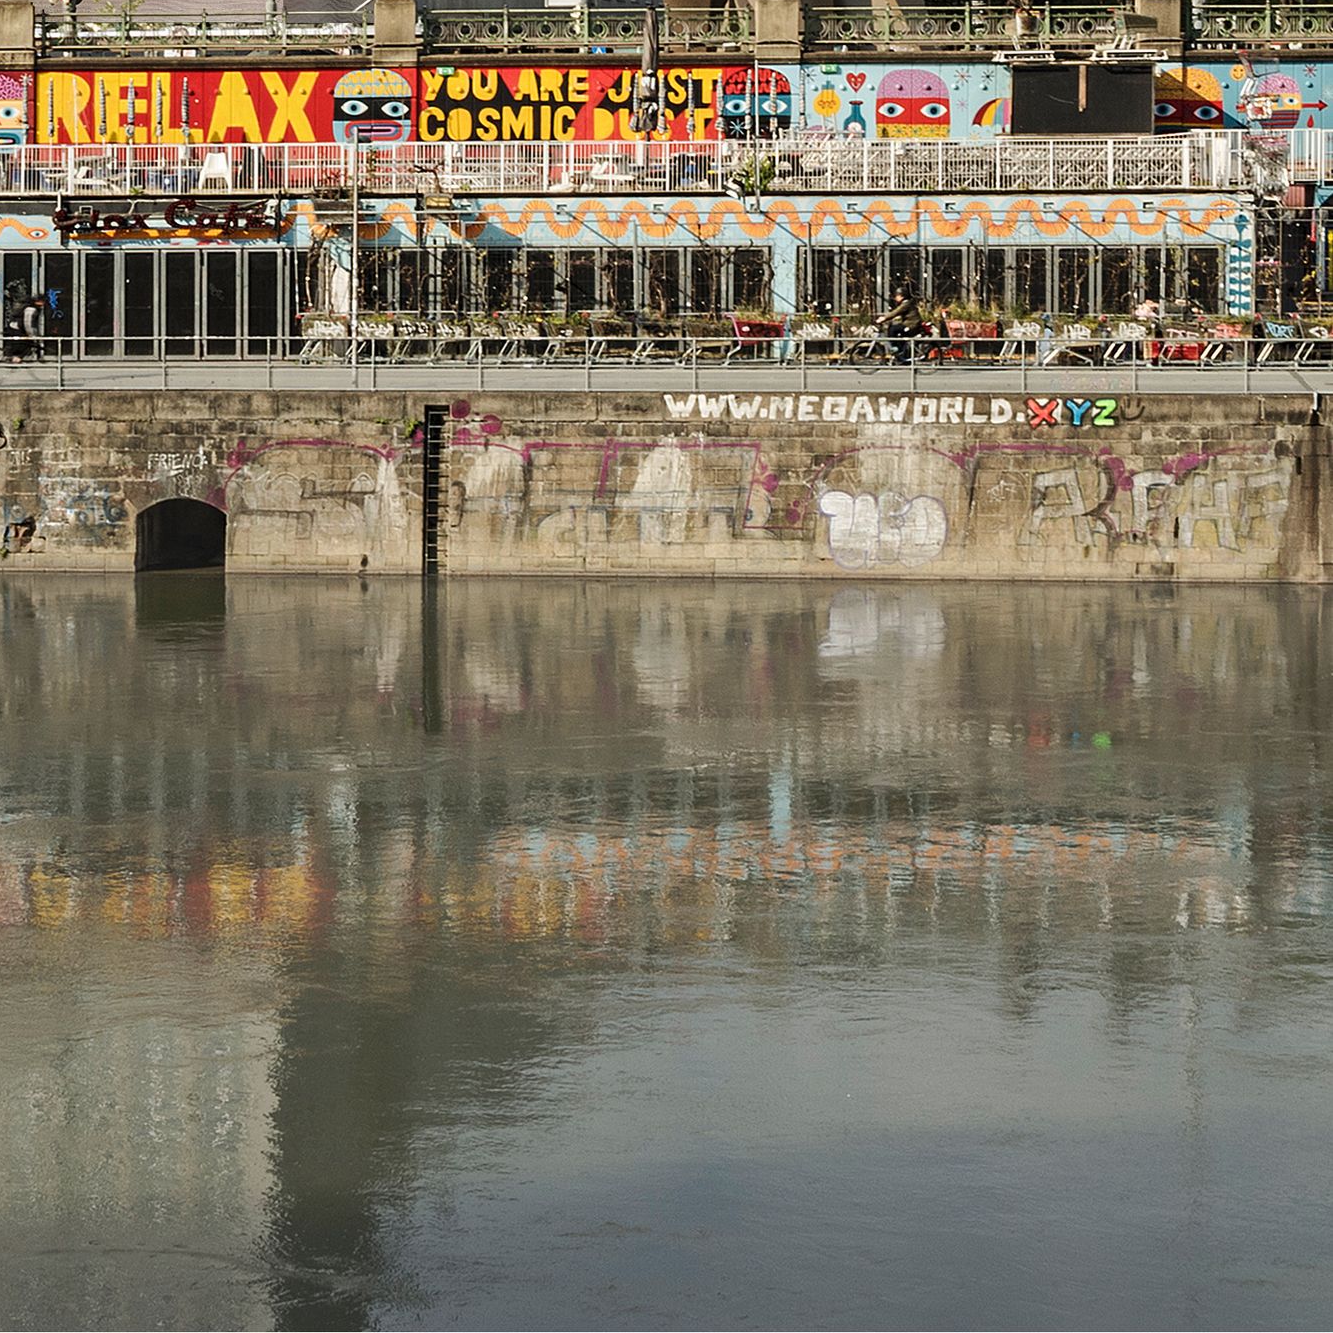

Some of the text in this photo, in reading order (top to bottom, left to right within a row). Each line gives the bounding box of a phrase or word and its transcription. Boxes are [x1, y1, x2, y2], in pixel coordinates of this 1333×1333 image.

[420, 68, 499, 101] YOU
[514, 68, 590, 102] ARE
[36, 71, 320, 144] RELAX
[418, 105, 577, 142] COSMIC
[664, 393, 1117, 427] WWW.MEGAWORLD.XYZ
